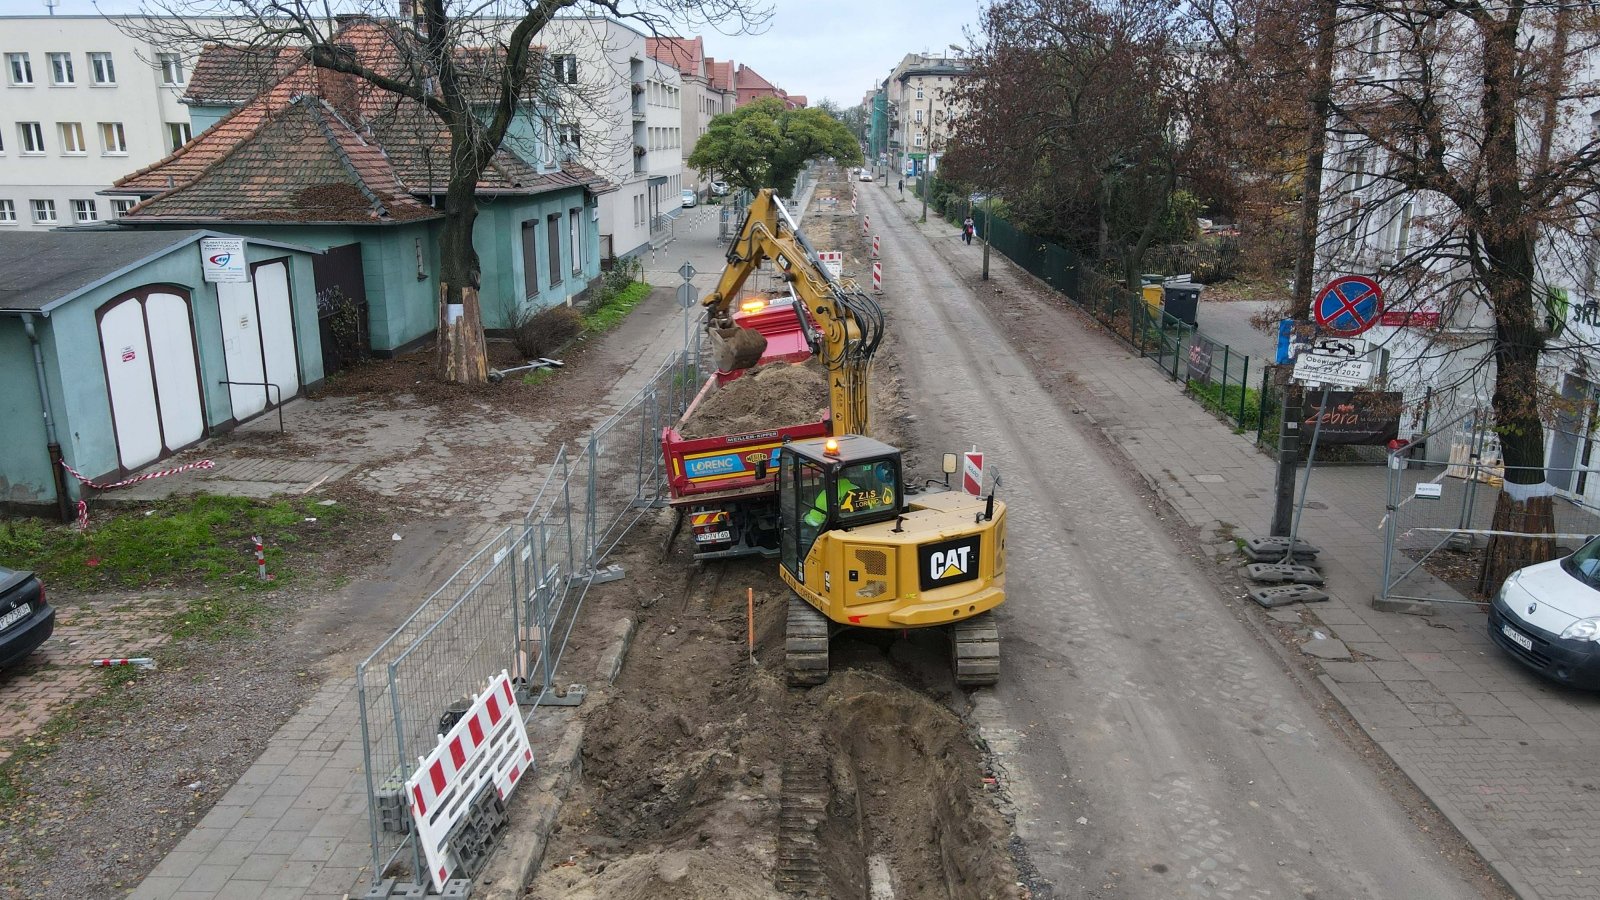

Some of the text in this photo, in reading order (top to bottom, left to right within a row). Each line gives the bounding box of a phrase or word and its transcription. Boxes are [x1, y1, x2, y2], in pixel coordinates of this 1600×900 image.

[1304, 403, 1358, 425] Zebra
[691, 457, 734, 472] LORENC
[930, 545, 971, 580] CAT
